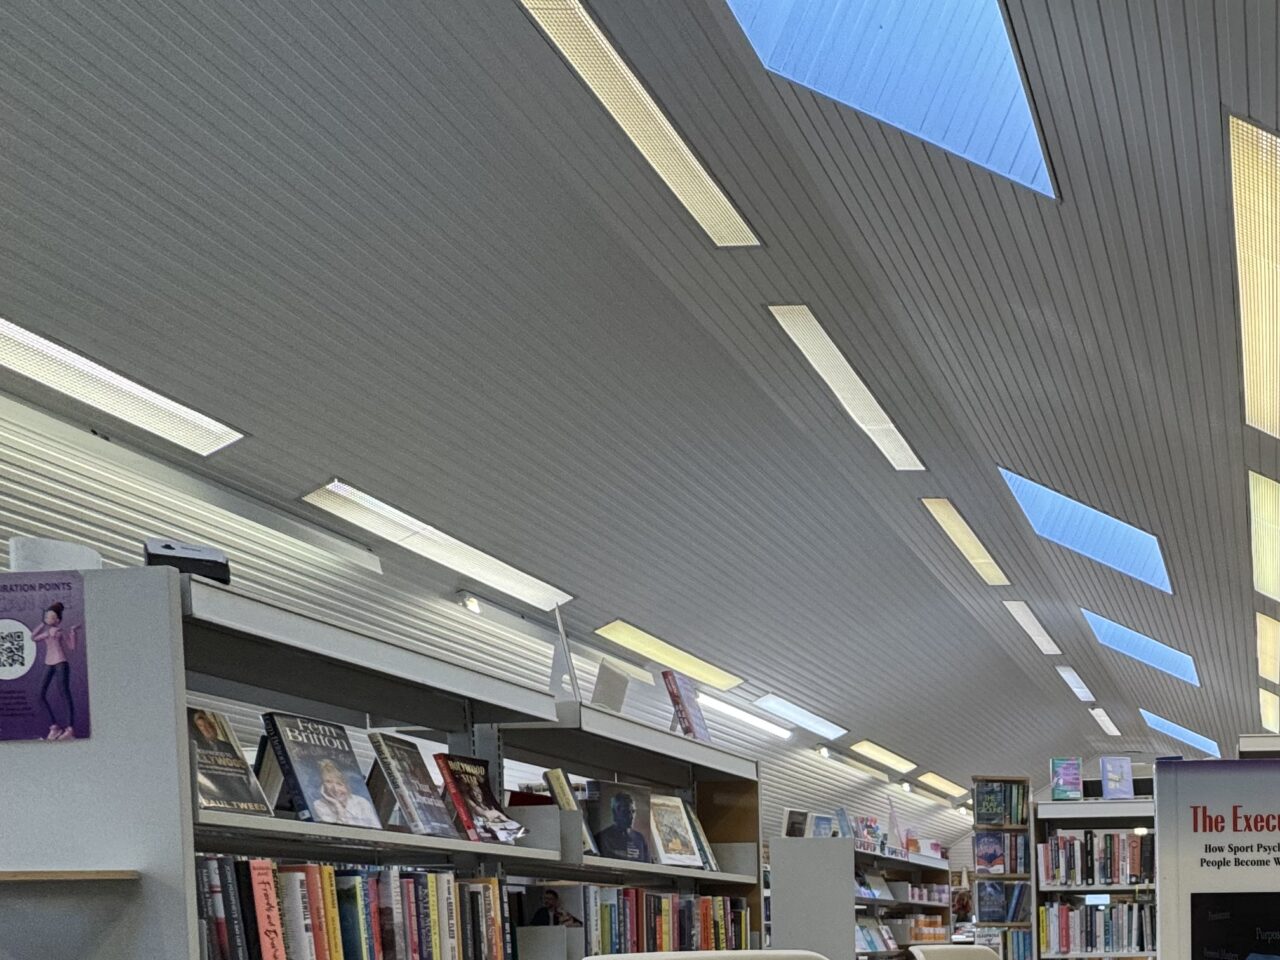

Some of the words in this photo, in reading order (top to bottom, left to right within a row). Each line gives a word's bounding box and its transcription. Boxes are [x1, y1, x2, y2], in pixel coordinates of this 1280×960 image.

[38, 582, 72, 591] POINTS
[286, 727, 350, 751] Britton
[233, 802, 267, 811] TWEED
[1190, 805, 1225, 833] The
[1204, 843, 1225, 853] How
[1228, 843, 1254, 856] Sport
[1200, 857, 1231, 869] People
[1234, 857, 1270, 868] Become
